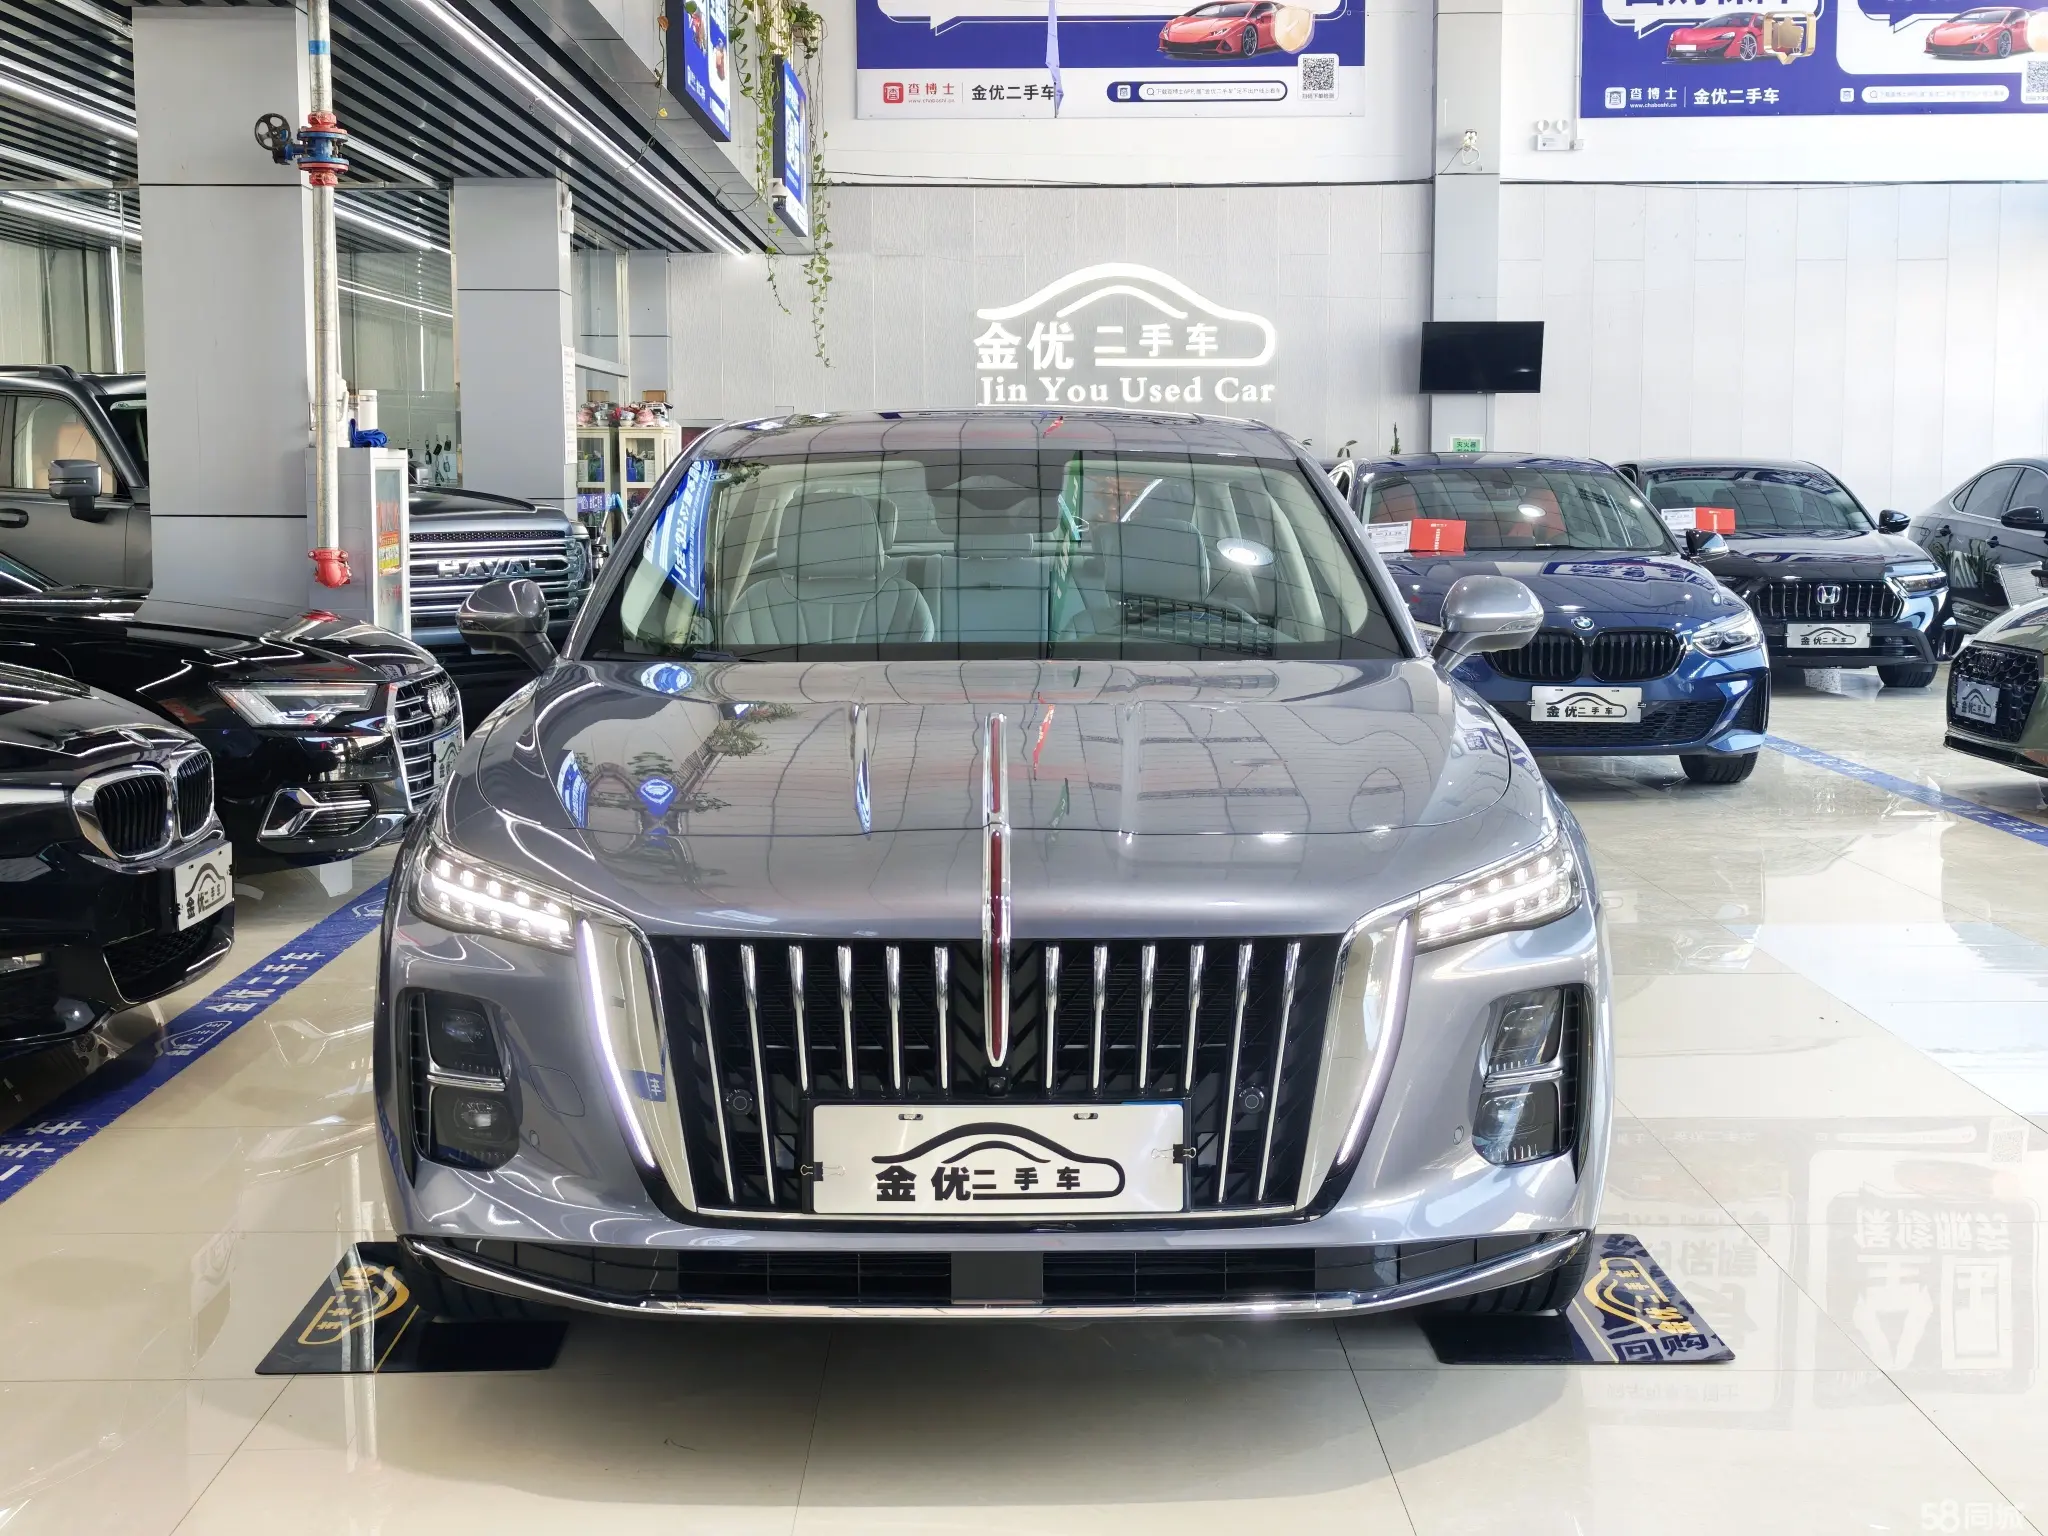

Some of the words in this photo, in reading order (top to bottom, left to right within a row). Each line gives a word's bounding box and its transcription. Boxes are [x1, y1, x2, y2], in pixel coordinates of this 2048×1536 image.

[908, 83, 955, 96] 查博士
[971, 84, 1055, 101] 金优二手车
[1629, 87, 1678, 100] 查博士
[1693, 87, 1780, 105] 金优二手车
[977, 376, 1027, 406] Jin
[1039, 376, 1109, 402] You
[1120, 376, 1203, 402] Used
[1214, 376, 1276, 402] Car
[437, 558, 546, 578] HAVAL
[875, 1165, 1081, 1202] 金优二手车
